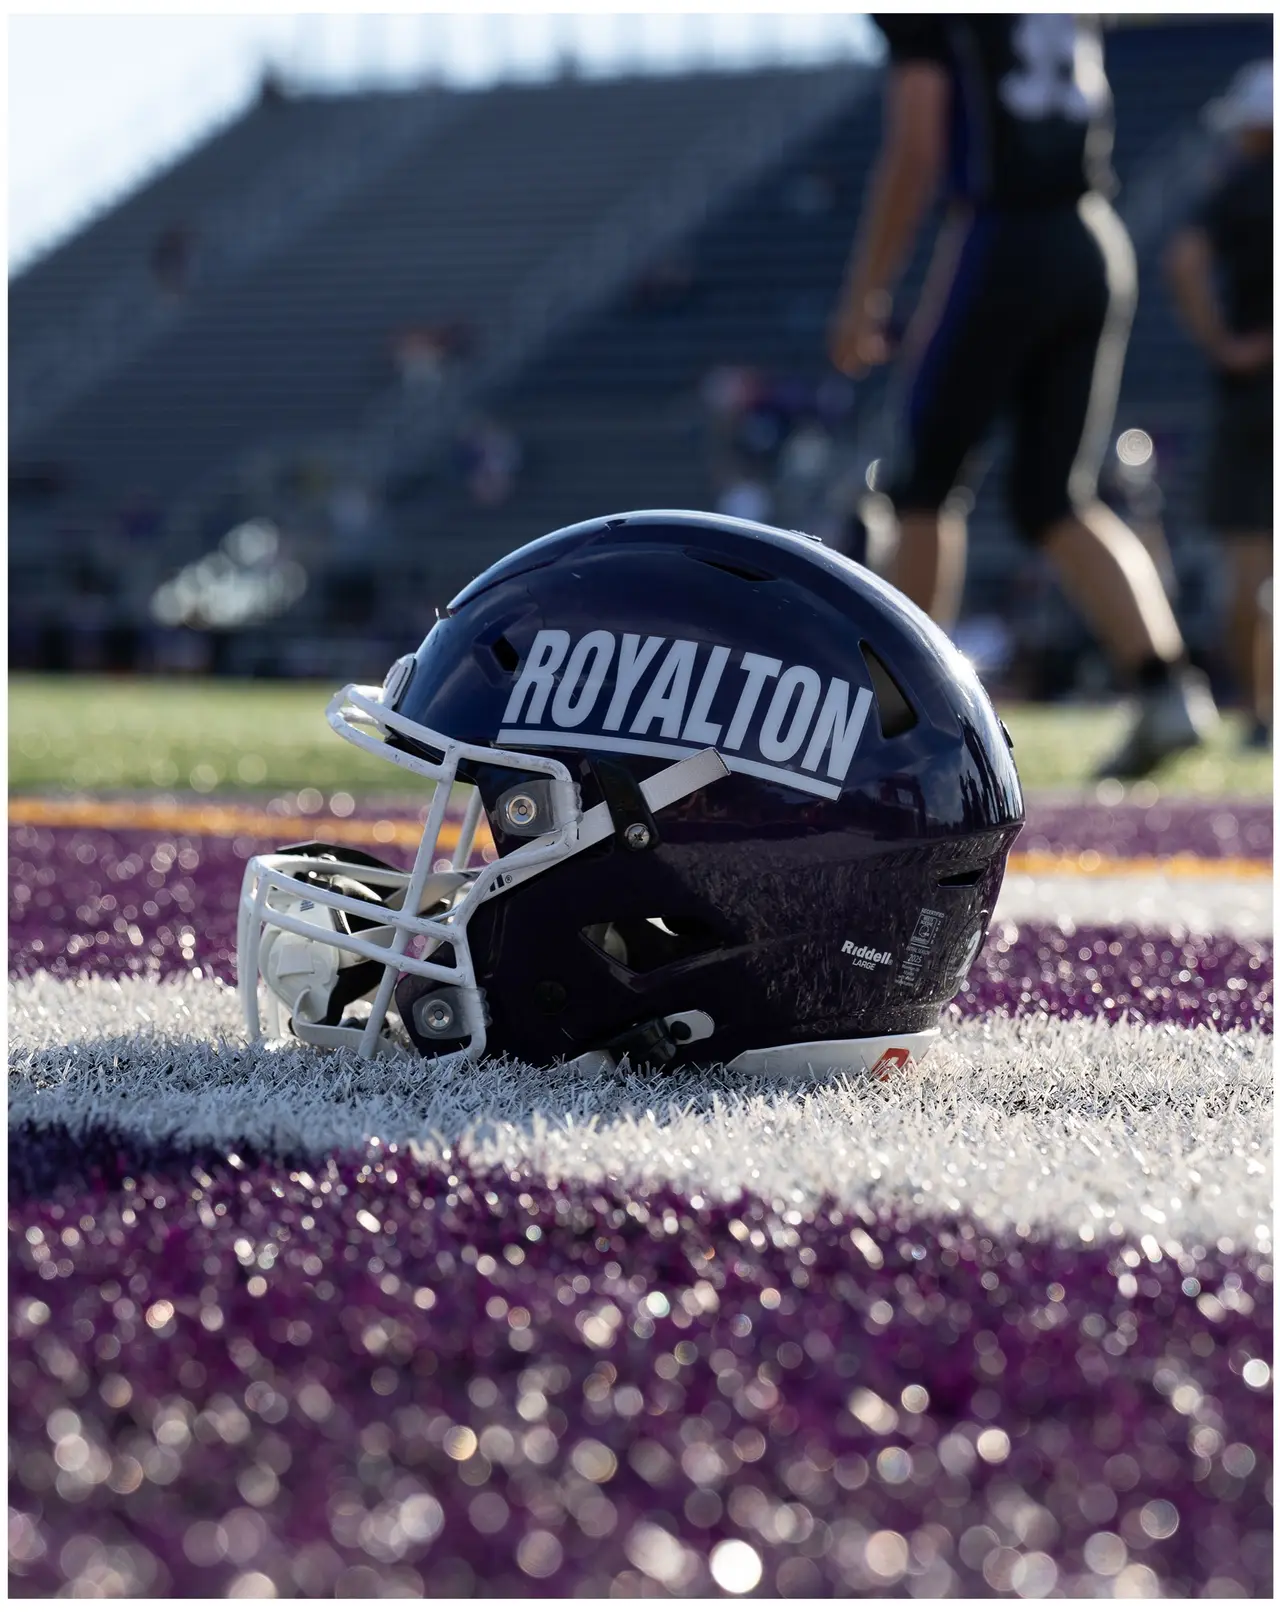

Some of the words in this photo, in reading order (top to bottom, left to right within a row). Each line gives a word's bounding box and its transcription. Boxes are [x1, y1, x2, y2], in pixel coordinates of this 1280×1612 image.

[501, 629, 874, 781] ROYALTON
[841, 940, 892, 965] Riddell
[852, 958, 876, 971] LARGE
